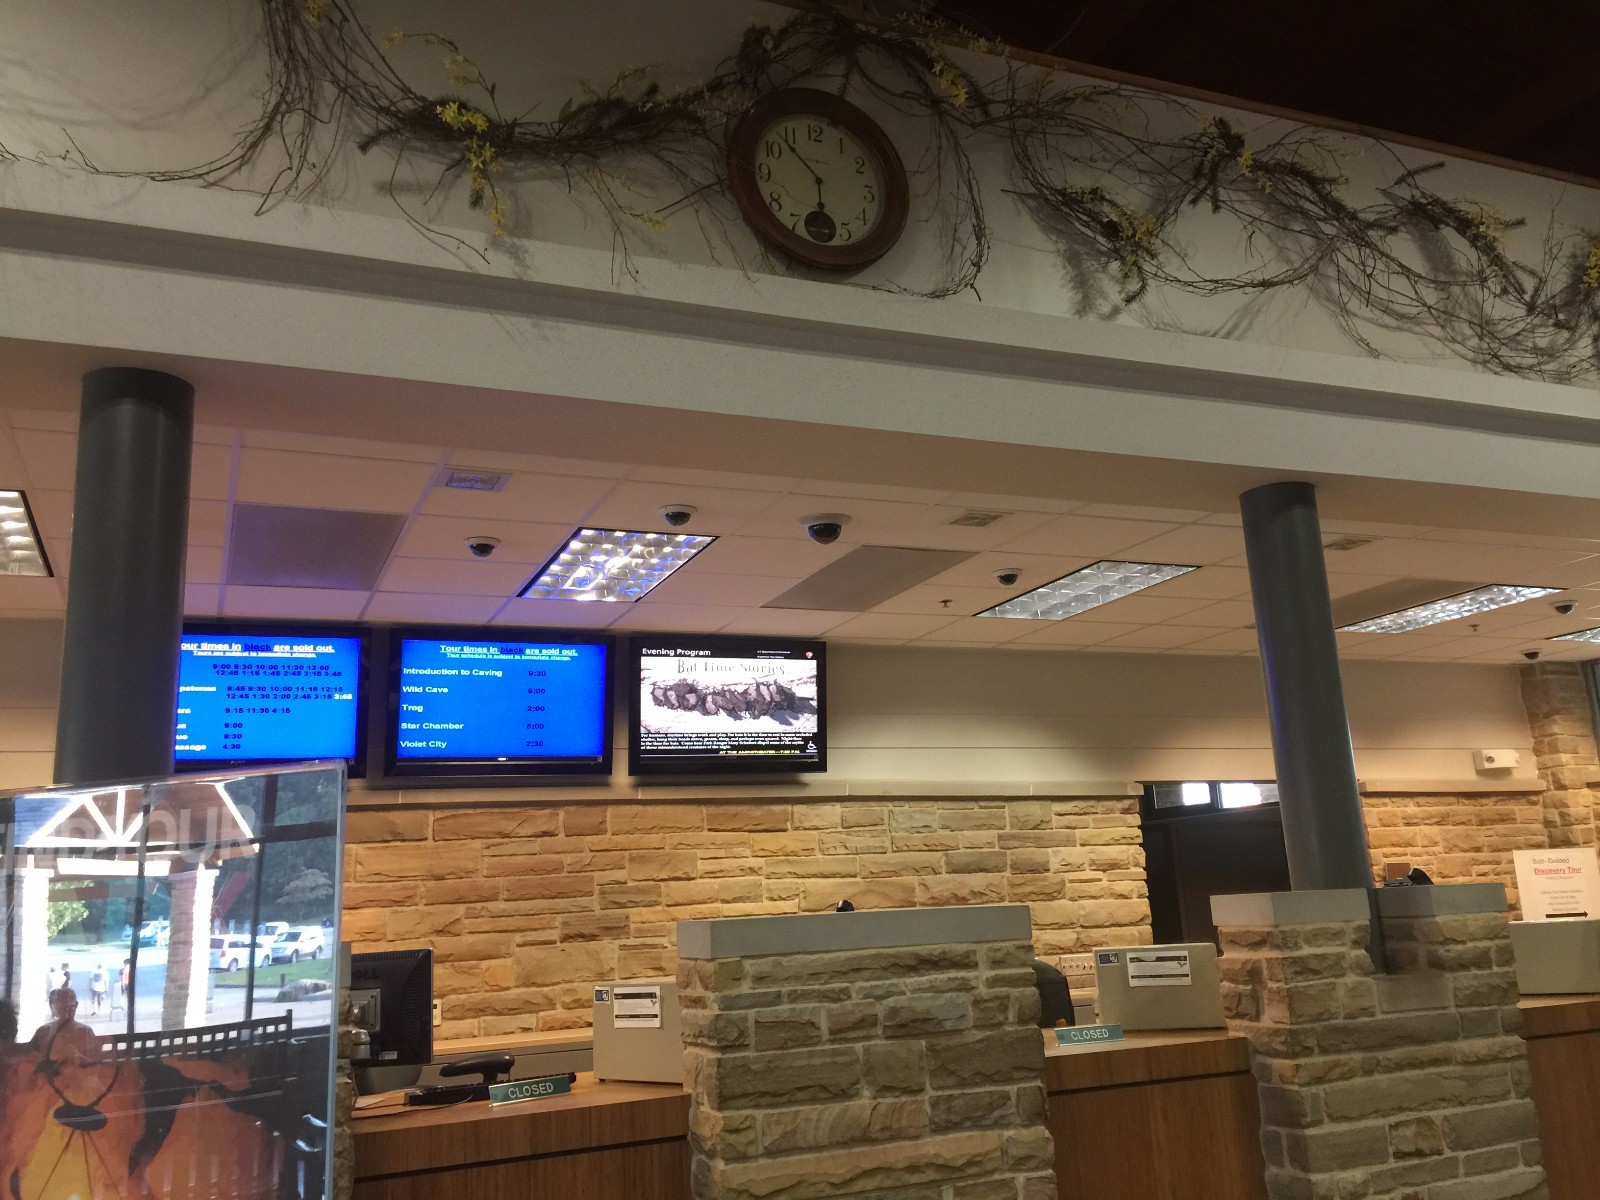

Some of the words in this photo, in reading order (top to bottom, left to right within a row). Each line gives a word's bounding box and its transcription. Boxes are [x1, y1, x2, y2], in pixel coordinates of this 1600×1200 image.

[784, 124, 796, 144] 11
[808, 124, 823, 143] 12
[765, 140, 782, 160] 10
[839, 137, 844, 154] 1
[758, 163, 771, 182] 9
[854, 156, 865, 174] 2
[769, 191, 782, 212] 8
[863, 185, 875, 203] 3
[789, 213, 801, 231] 7
[855, 208, 867, 226] 4
[839, 222, 851, 241] 5
[181, 643, 198, 651] our
[201, 643, 229, 651] times
[232, 643, 241, 651] in
[245, 643, 271, 651] black
[273, 644, 290, 652] are
[293, 644, 314, 652] sold
[316, 645, 335, 653] out.
[440, 645, 461, 653] Tour
[463, 645, 487, 654] times
[490, 646, 498, 654] in
[500, 647, 523, 655] black
[525, 648, 539, 656] are
[541, 648, 559, 656] sold
[562, 649, 578, 657] out.
[642, 648, 675, 656] Evening
[677, 648, 711, 657] Program
[403, 667, 458, 675] Introduction
[472, 669, 502, 677] Caving
[402, 704, 423, 712] Trog
[1534, 867, 1566, 875] Discovery
[1070, 1029, 1109, 1041] CLOSED
[508, 1082, 554, 1099] CLOSED
